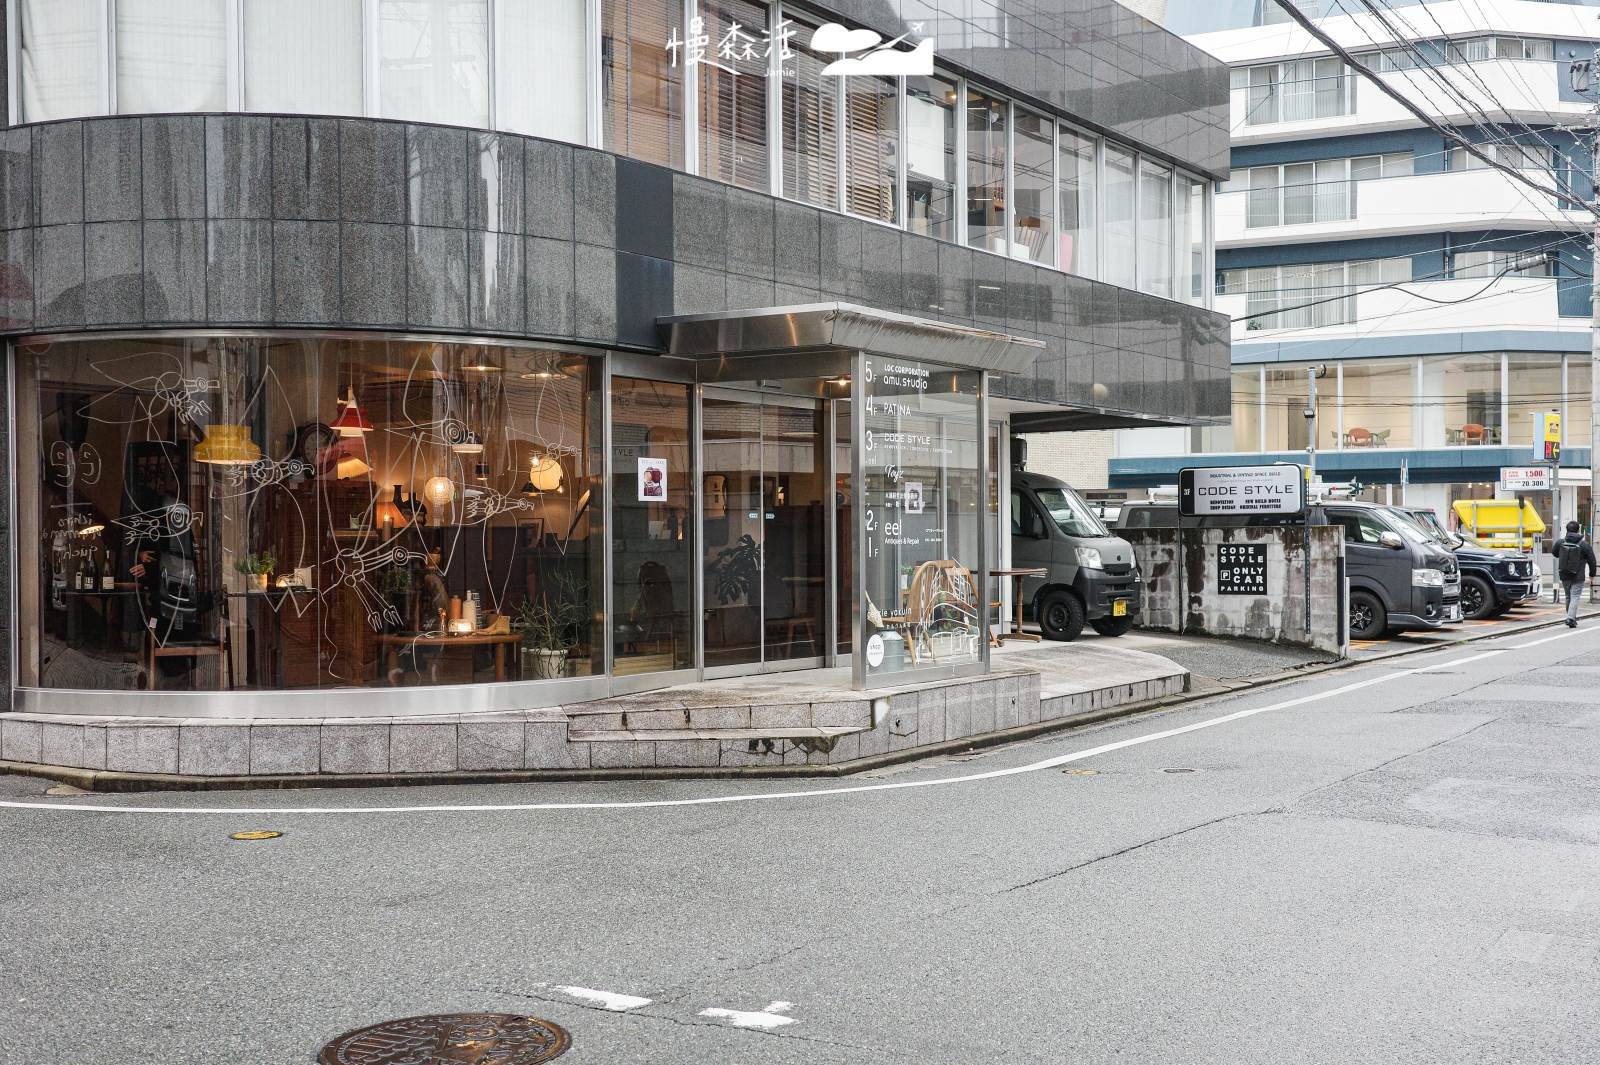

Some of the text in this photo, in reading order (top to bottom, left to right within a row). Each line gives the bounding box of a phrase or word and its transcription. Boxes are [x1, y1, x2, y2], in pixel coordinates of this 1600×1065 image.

[895, 365, 930, 378] CORPORATION
[883, 402, 912, 417] PATINA
[884, 433, 931, 445] CODE STYLE
[1183, 488, 1191, 496] 3F
[1198, 484, 1294, 496] CODE STYLE
[884, 518, 902, 536] eel
[884, 537, 902, 546] Antiques
[907, 538, 920, 546] Repair
[1220, 555, 1264, 563] STYLE
[1233, 567, 1264, 575] ONLY
[1233, 576, 1264, 584] CAR
